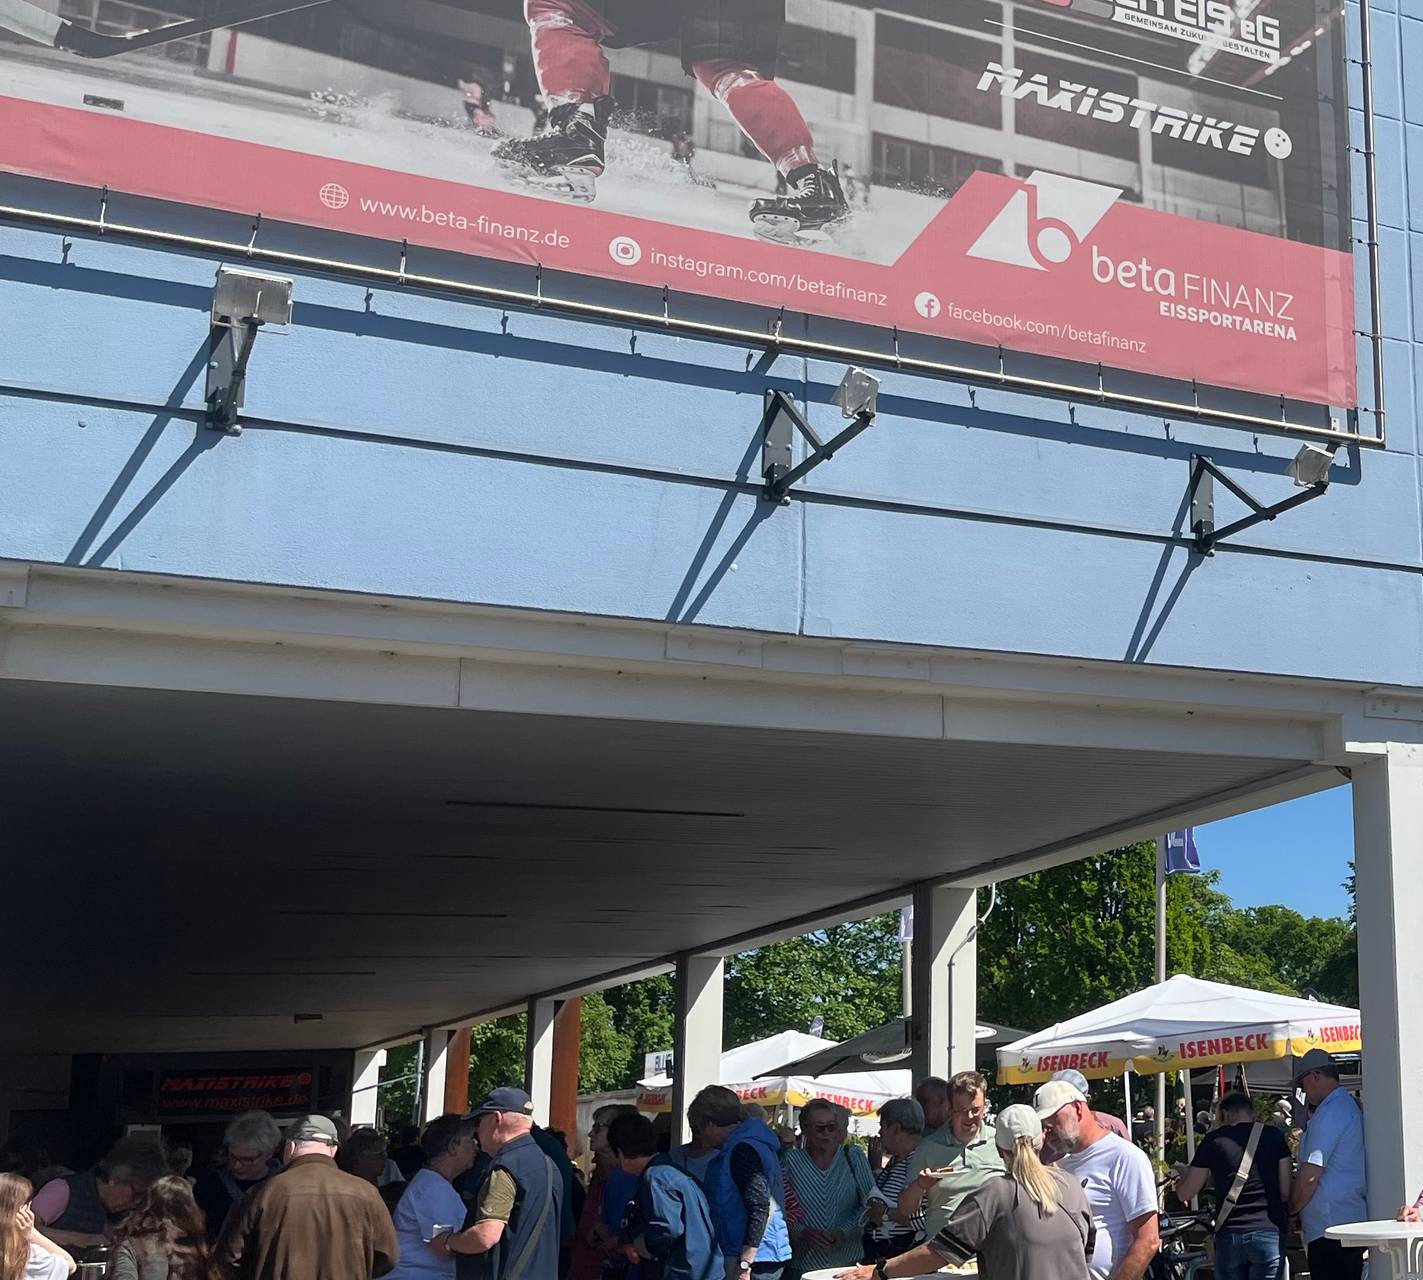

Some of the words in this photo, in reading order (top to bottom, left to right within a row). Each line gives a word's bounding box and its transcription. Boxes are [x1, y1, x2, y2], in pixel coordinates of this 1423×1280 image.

[1124, 12, 1178, 33] GEMEINSAM
[1222, 40, 1271, 59] GESTALTEN
[1241, 15, 1280, 48] eG
[360, 195, 571, 249] www.beta-finanz.de
[650, 247, 888, 307] instagram.com/betafinanz
[1091, 245, 1176, 297] beta
[1183, 273, 1295, 321] FINANZ
[947, 302, 1147, 354] facebook.com/betafinanz
[1160, 301, 1297, 342] EISSPORTARENA
[1179, 1033, 1269, 1059] ISENBECK
[1320, 1025, 1361, 1043] ISENBEC
[1036, 1051, 1110, 1073] ISENBECK
[735, 1087, 768, 1101] BECK
